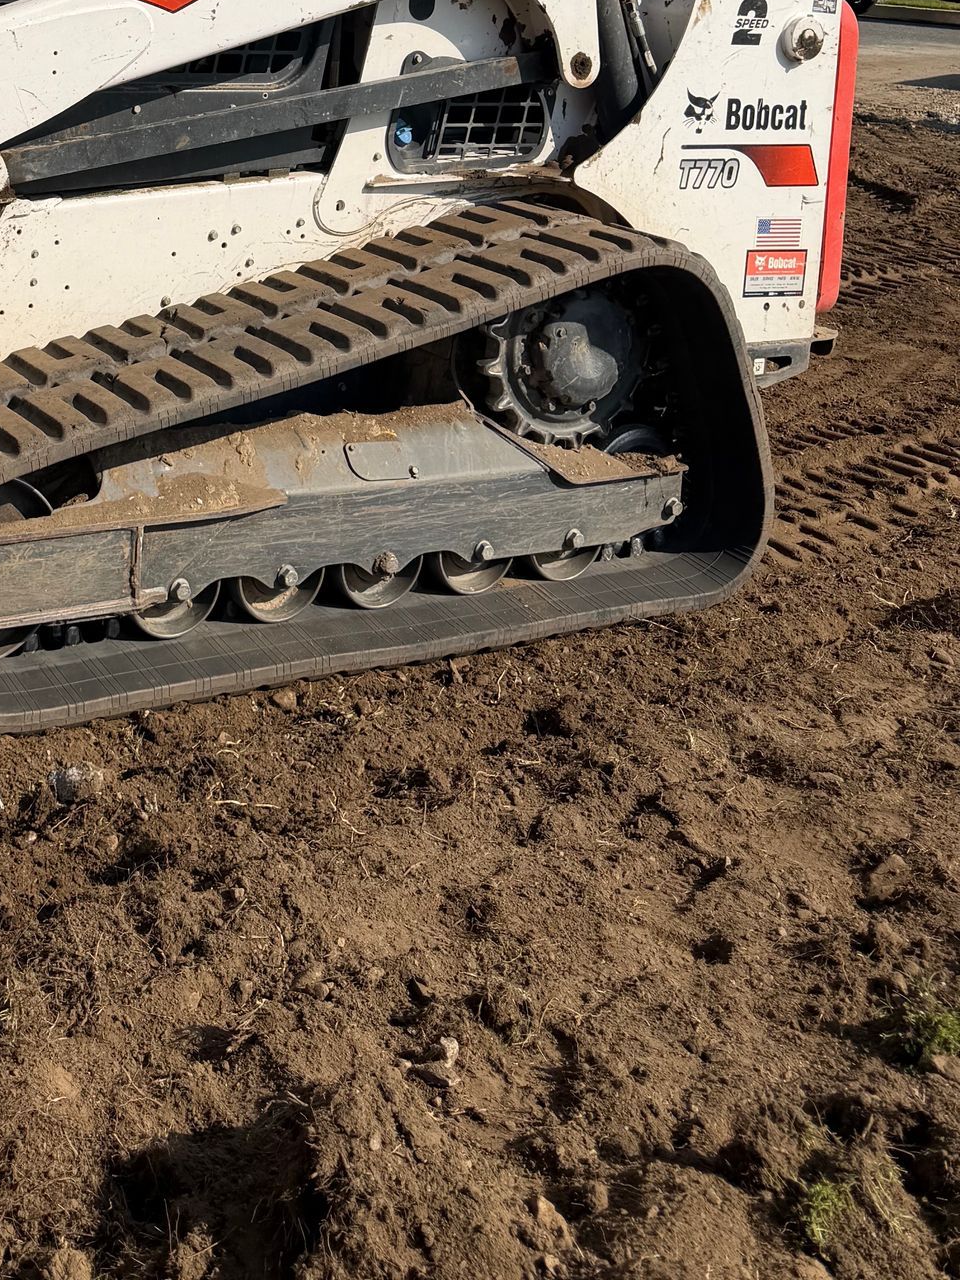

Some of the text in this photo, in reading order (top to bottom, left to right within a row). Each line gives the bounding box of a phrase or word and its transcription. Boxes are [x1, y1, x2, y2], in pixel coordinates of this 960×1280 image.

[735, 18, 769, 29] SPEED
[725, 98, 808, 130] Bobcat
[679, 158, 740, 189] T770
[768, 257, 797, 269] Bobcat
